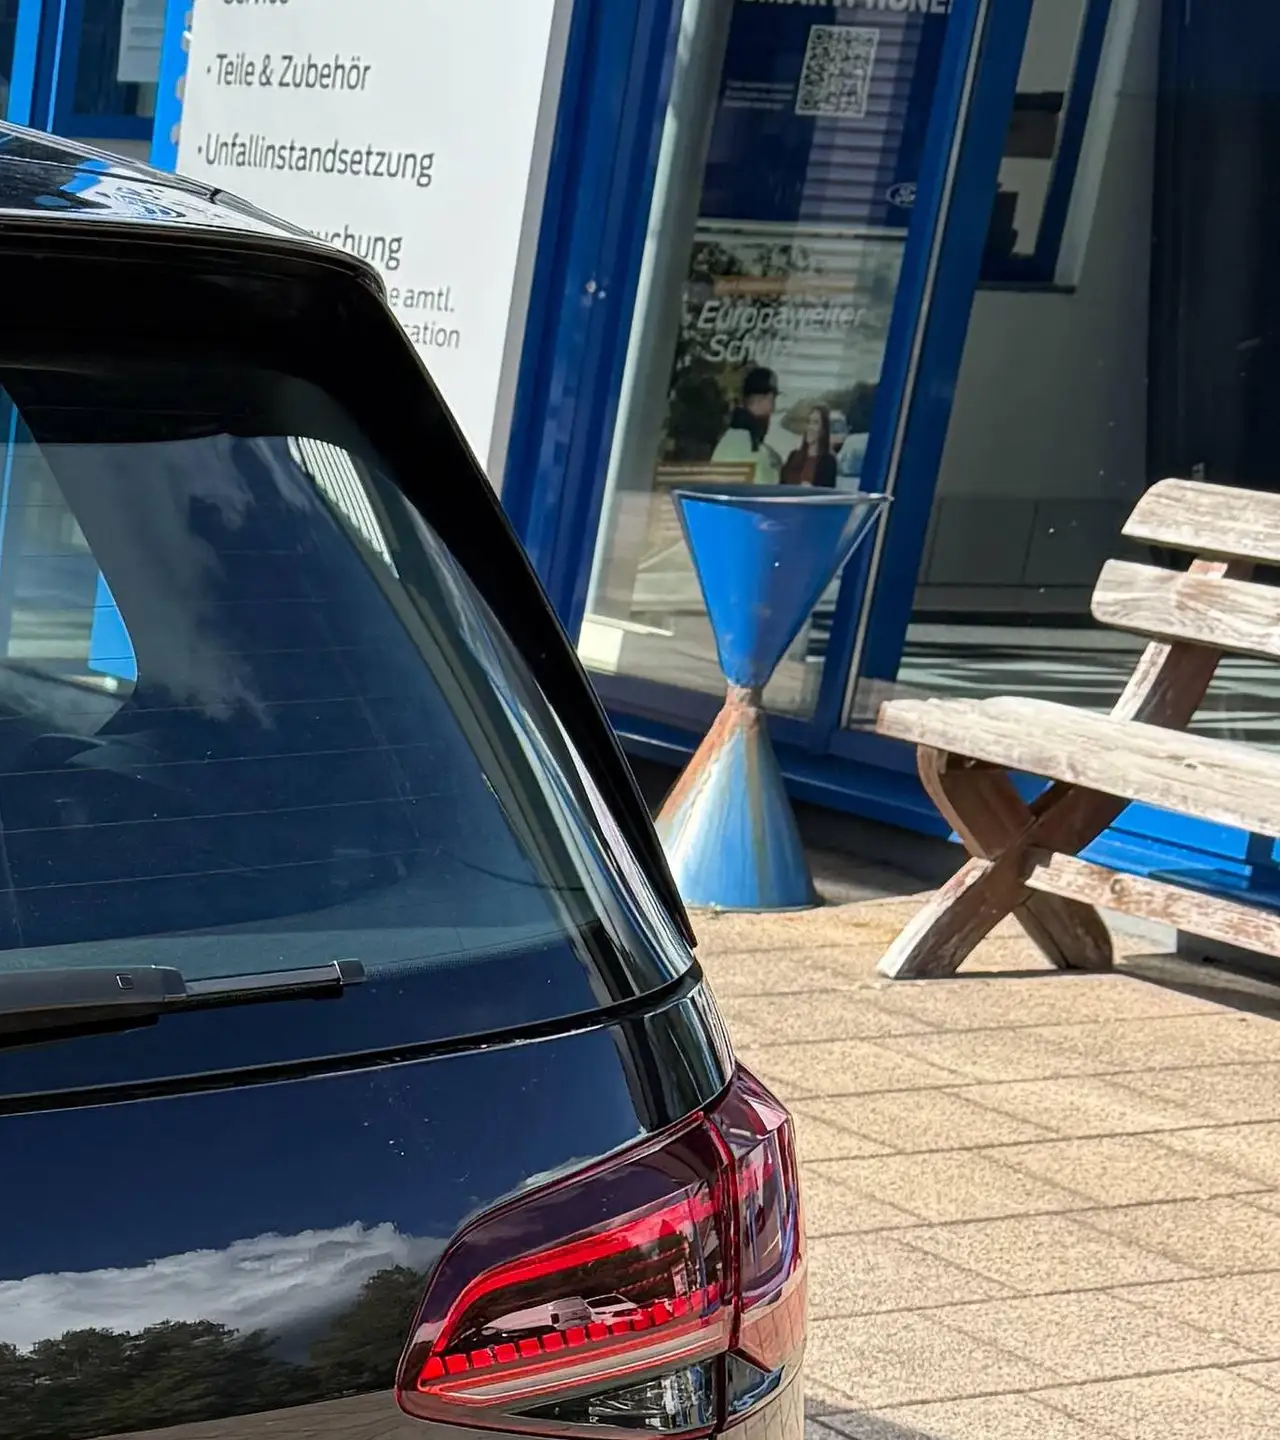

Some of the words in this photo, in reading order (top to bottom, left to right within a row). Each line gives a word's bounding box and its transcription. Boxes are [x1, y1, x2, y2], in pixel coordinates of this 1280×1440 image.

[216, 52, 255, 86] Teile
[259, 54, 273, 88] &
[279, 54, 371, 91] Zubehör
[205, 133, 435, 187] Unfallinstandsetzung
[403, 285, 455, 313] amtl.
